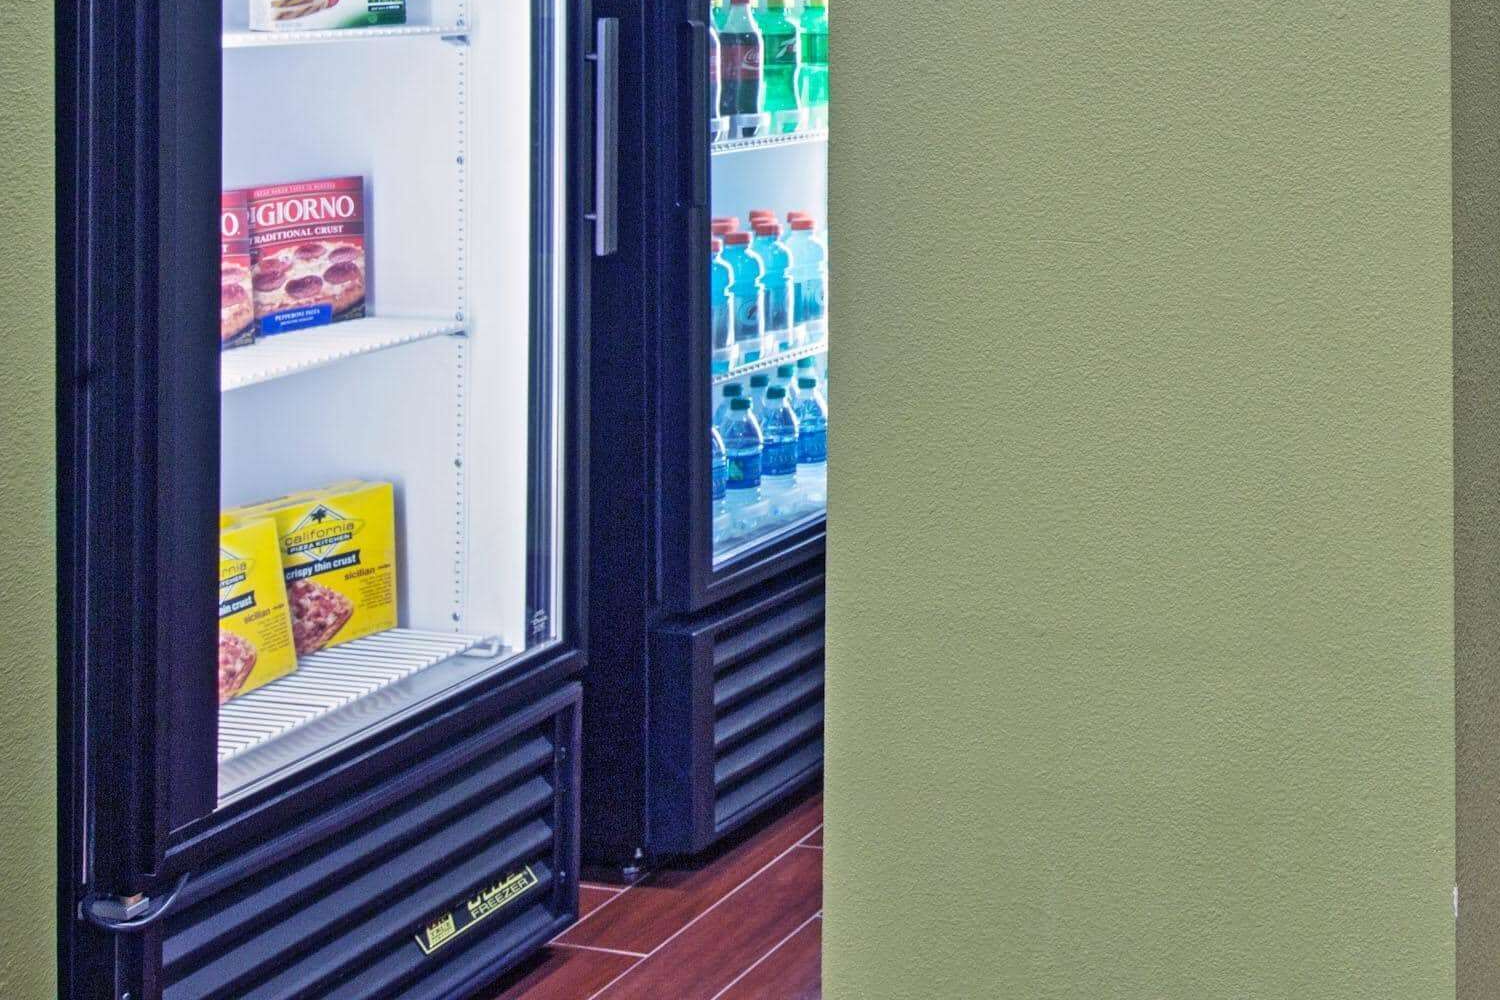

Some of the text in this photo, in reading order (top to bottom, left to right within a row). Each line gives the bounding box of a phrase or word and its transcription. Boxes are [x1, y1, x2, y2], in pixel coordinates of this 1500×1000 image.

[315, 224, 344, 237] CRUST
[290, 534, 351, 553] PIZZA KITCHEN
[286, 554, 357, 580] crispy thin crust
[470, 877, 530, 920] FREEZER
